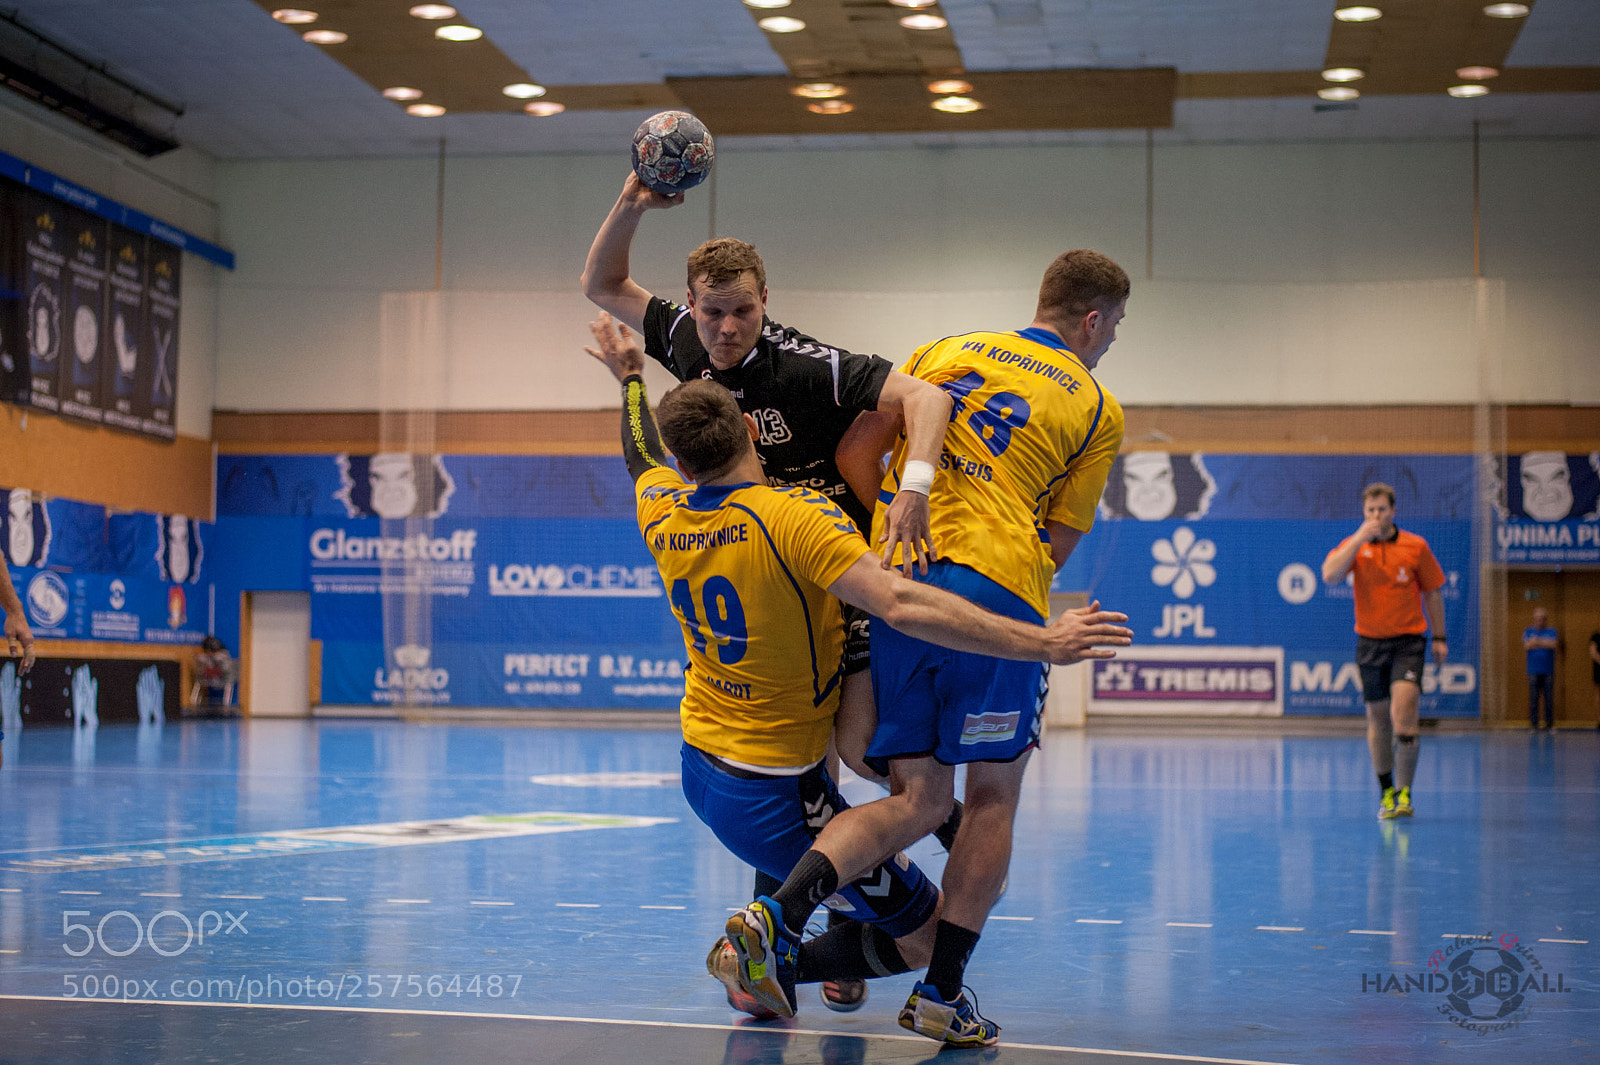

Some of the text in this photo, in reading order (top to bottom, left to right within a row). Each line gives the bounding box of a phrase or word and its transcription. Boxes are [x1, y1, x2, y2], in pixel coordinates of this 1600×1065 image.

[961, 341, 1082, 395] KH KOPŘIVNICE
[752, 408, 793, 446] 13
[938, 371, 1031, 457] 18
[310, 528, 477, 560] Glanzstoff
[654, 523, 748, 551] KH KOPŘIVNICE
[1497, 524, 1573, 548] UNIMA
[671, 575, 748, 665] 19
[1153, 604, 1216, 638] JPL
[504, 654, 589, 677] PERFECT
[1138, 667, 1274, 692] TREMIS
